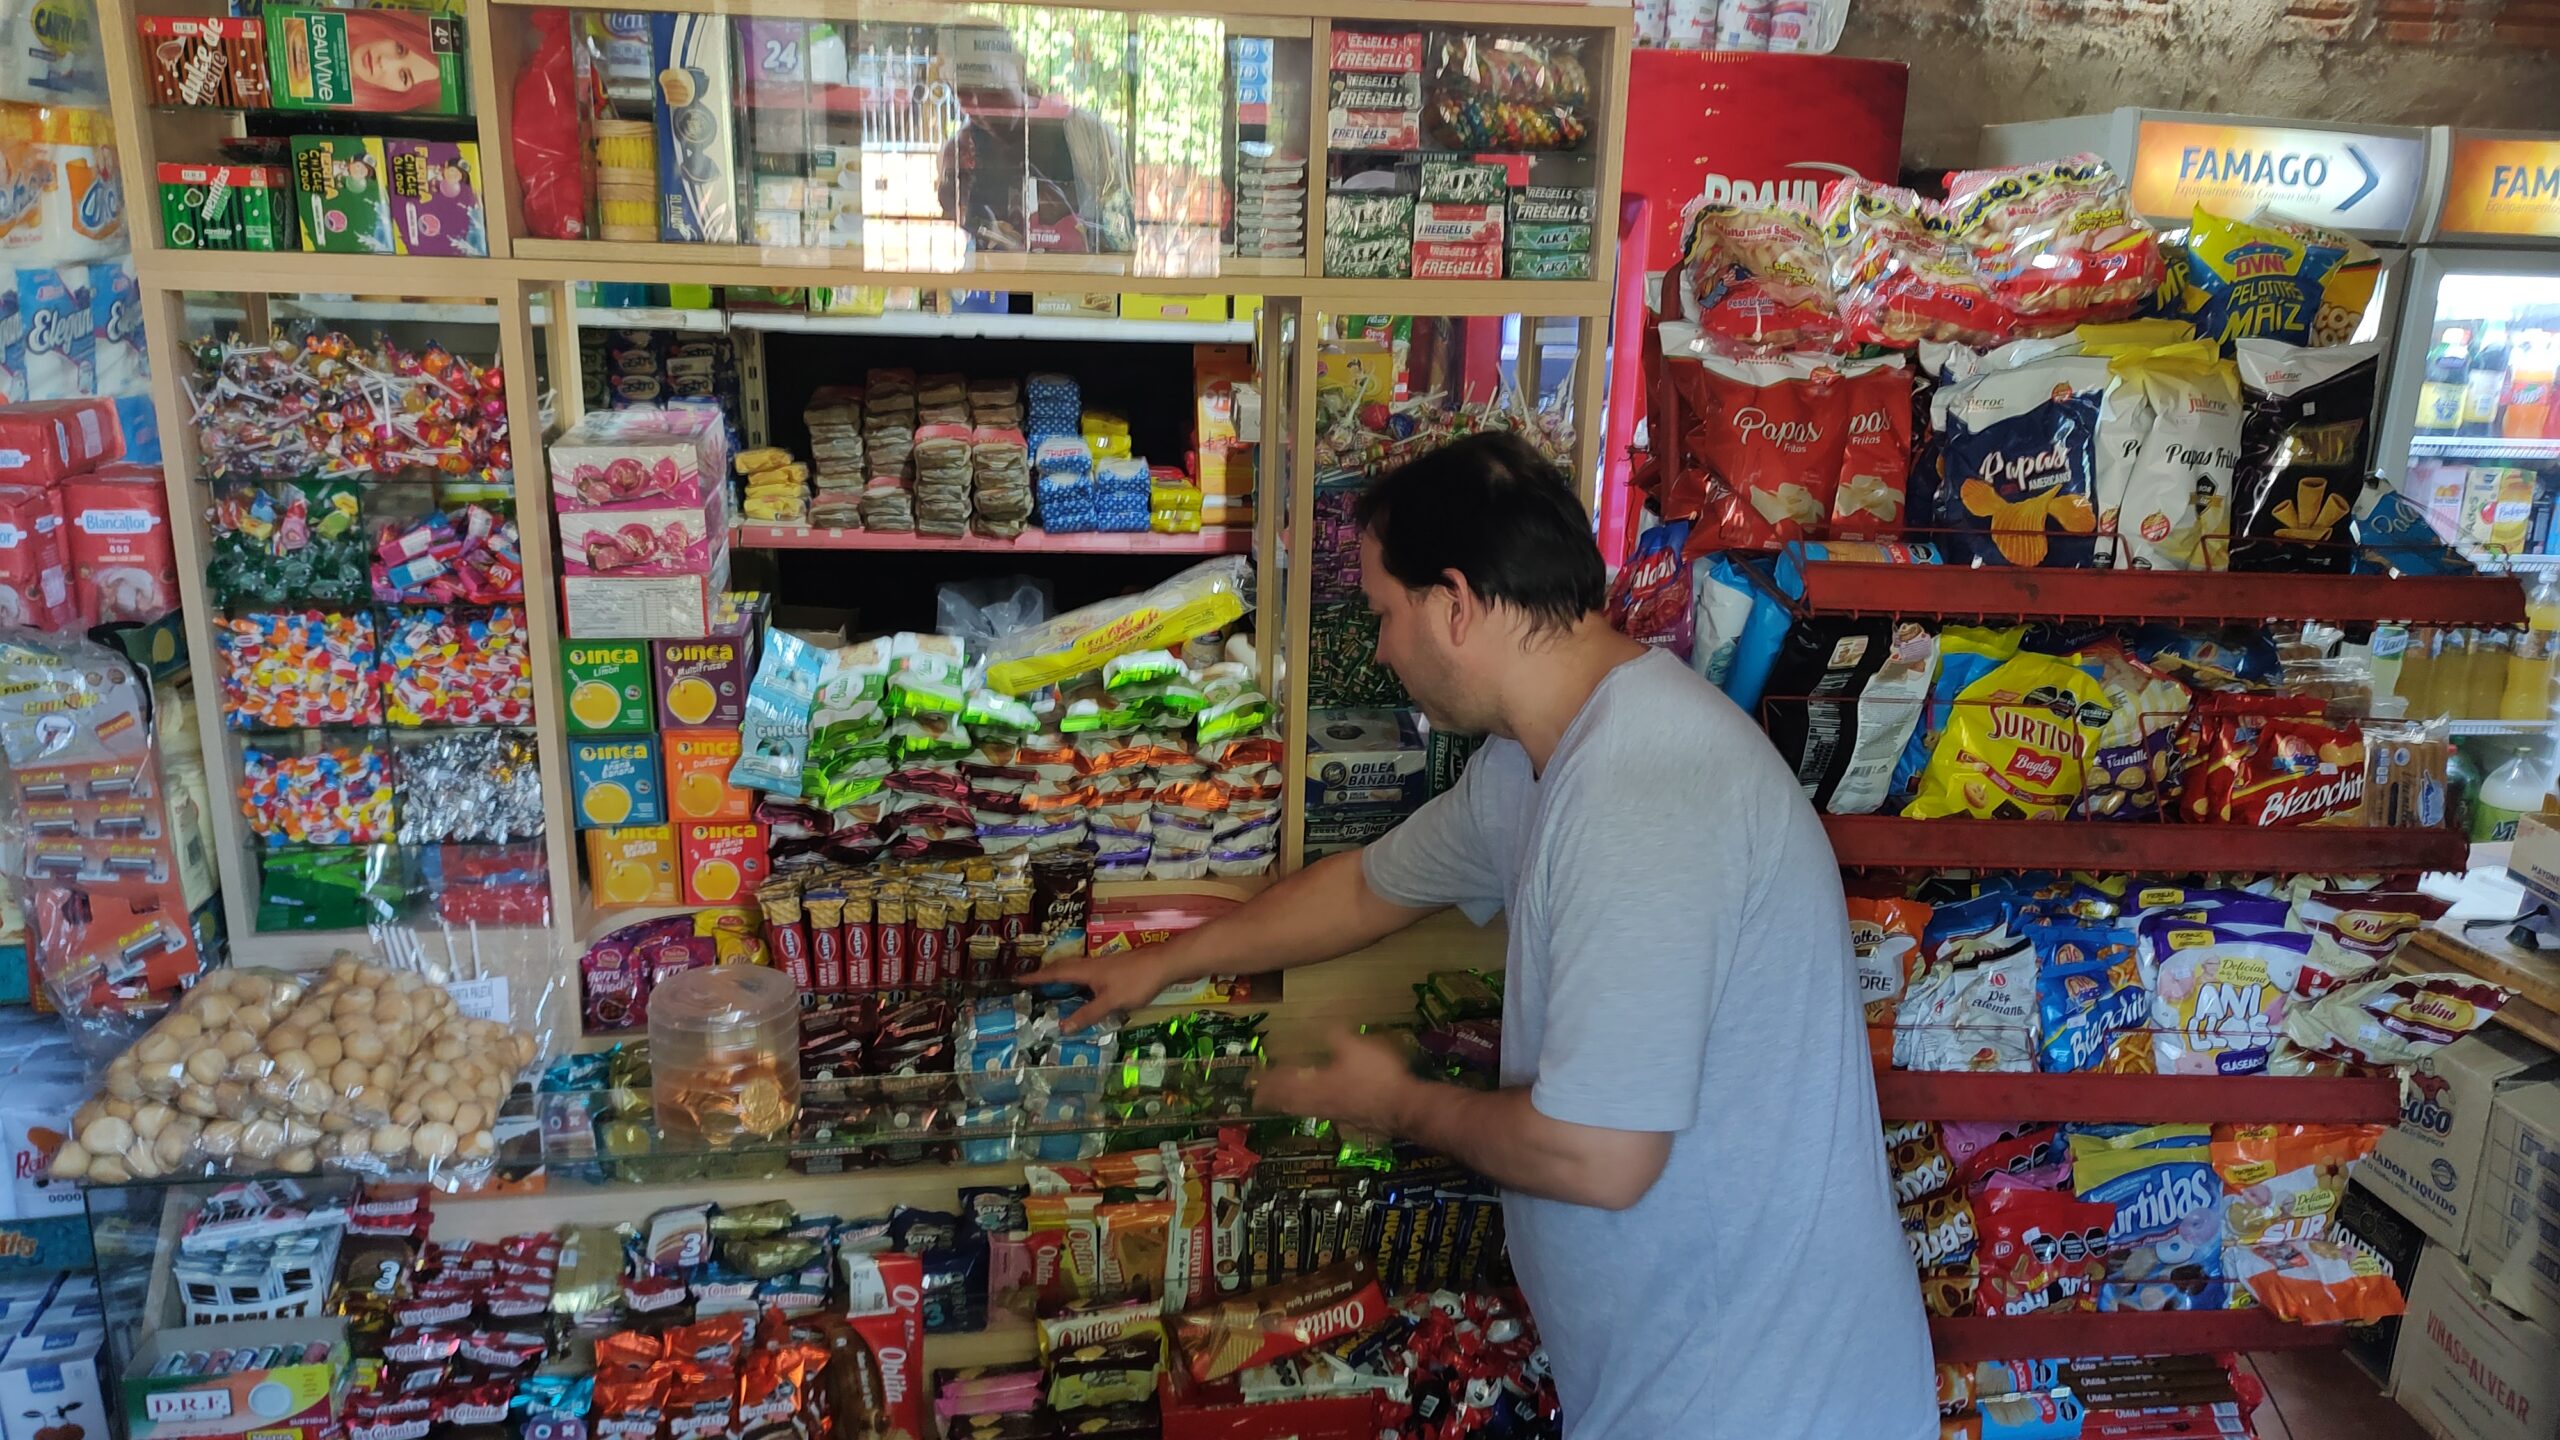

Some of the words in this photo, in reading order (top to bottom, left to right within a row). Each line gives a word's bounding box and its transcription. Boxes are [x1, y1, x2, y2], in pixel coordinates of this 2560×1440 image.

[762, 39, 798, 70] 24
[2179, 145, 2329, 188] FAMAGO
[2490, 166, 2560, 199] FAM
[1536, 233, 1570, 245] ALKA
[1535, 262, 1570, 274] ALKA
[1732, 406, 1824, 446] Papas
[1852, 434, 1881, 446] Fritas
[1782, 442, 1808, 454] Fritas
[2166, 442, 2211, 472] Papas
[86, 512, 148, 532] Blancaflor
[1351, 761, 1397, 775] OBLEA
[1435, 734, 1447, 790] FREEGELLS
[2016, 753, 2056, 780] Bagley
[2258, 772, 2366, 829] Bizcochit
[2220, 960, 2267, 976] Delicias
[2110, 1168, 2212, 1238] urtidas
[2409, 1175, 2458, 1217] LIQUIDO
[680, 1232, 702, 1259] 3
[373, 1260, 401, 1291] 3
[1296, 1300, 1366, 1345] Oblita
[878, 1346, 907, 1403] Oblita
[2468, 1357, 2530, 1425] ALVEAR
